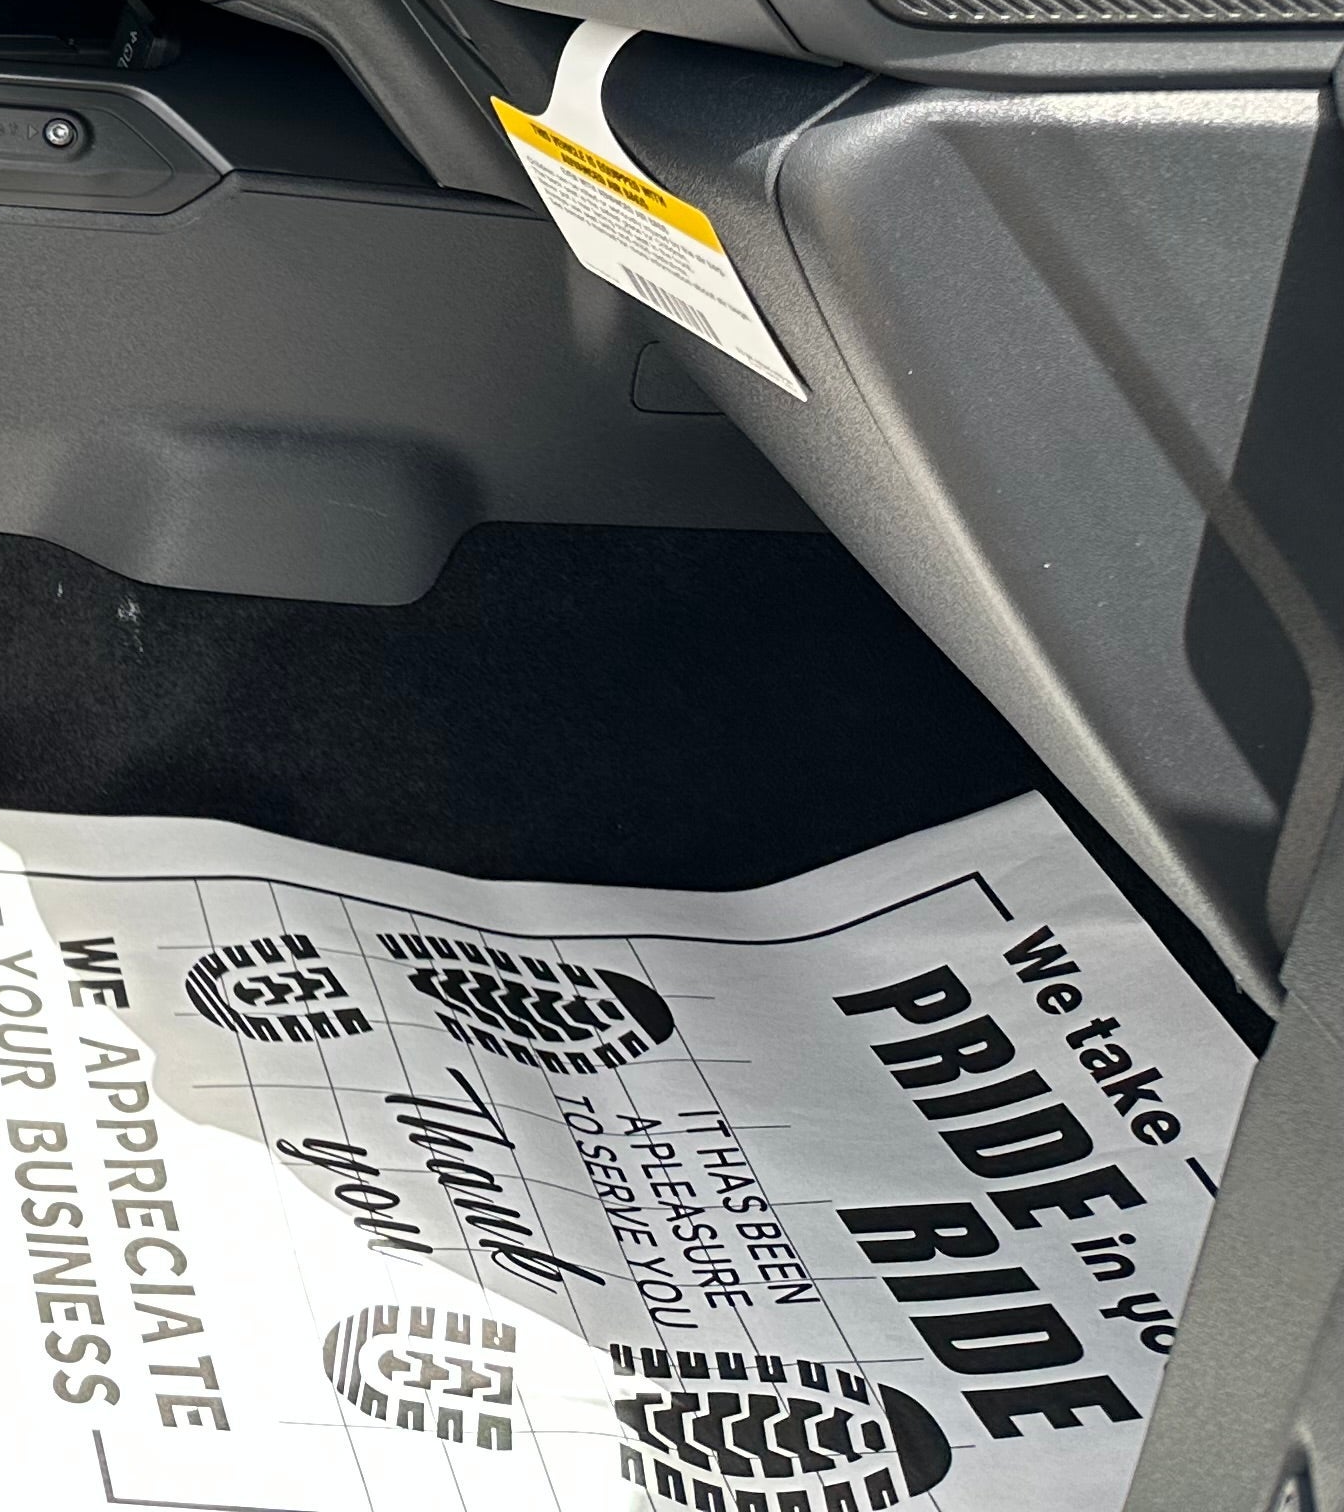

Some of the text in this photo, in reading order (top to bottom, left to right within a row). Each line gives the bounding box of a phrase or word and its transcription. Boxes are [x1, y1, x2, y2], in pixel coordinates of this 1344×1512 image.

[832, 963, 1148, 1231] PRIDE
[1071, 1232, 1138, 1283] in
[1002, 924, 1182, 1146] We take
[5, 1117, 122, 1407] BUSINESS
[58, 936, 231, 1432] WE APPRECIATE
[275, 1138, 434, 1266] you
[384, 1067, 606, 1295] Thank
[554, 1095, 699, 1330] TO SERVE YOU
[616, 1113, 753, 1310] A PLEASURE
[678, 1110, 821, 1305] IT HAS BEEN
[835, 1201, 1144, 1440] RIDE
